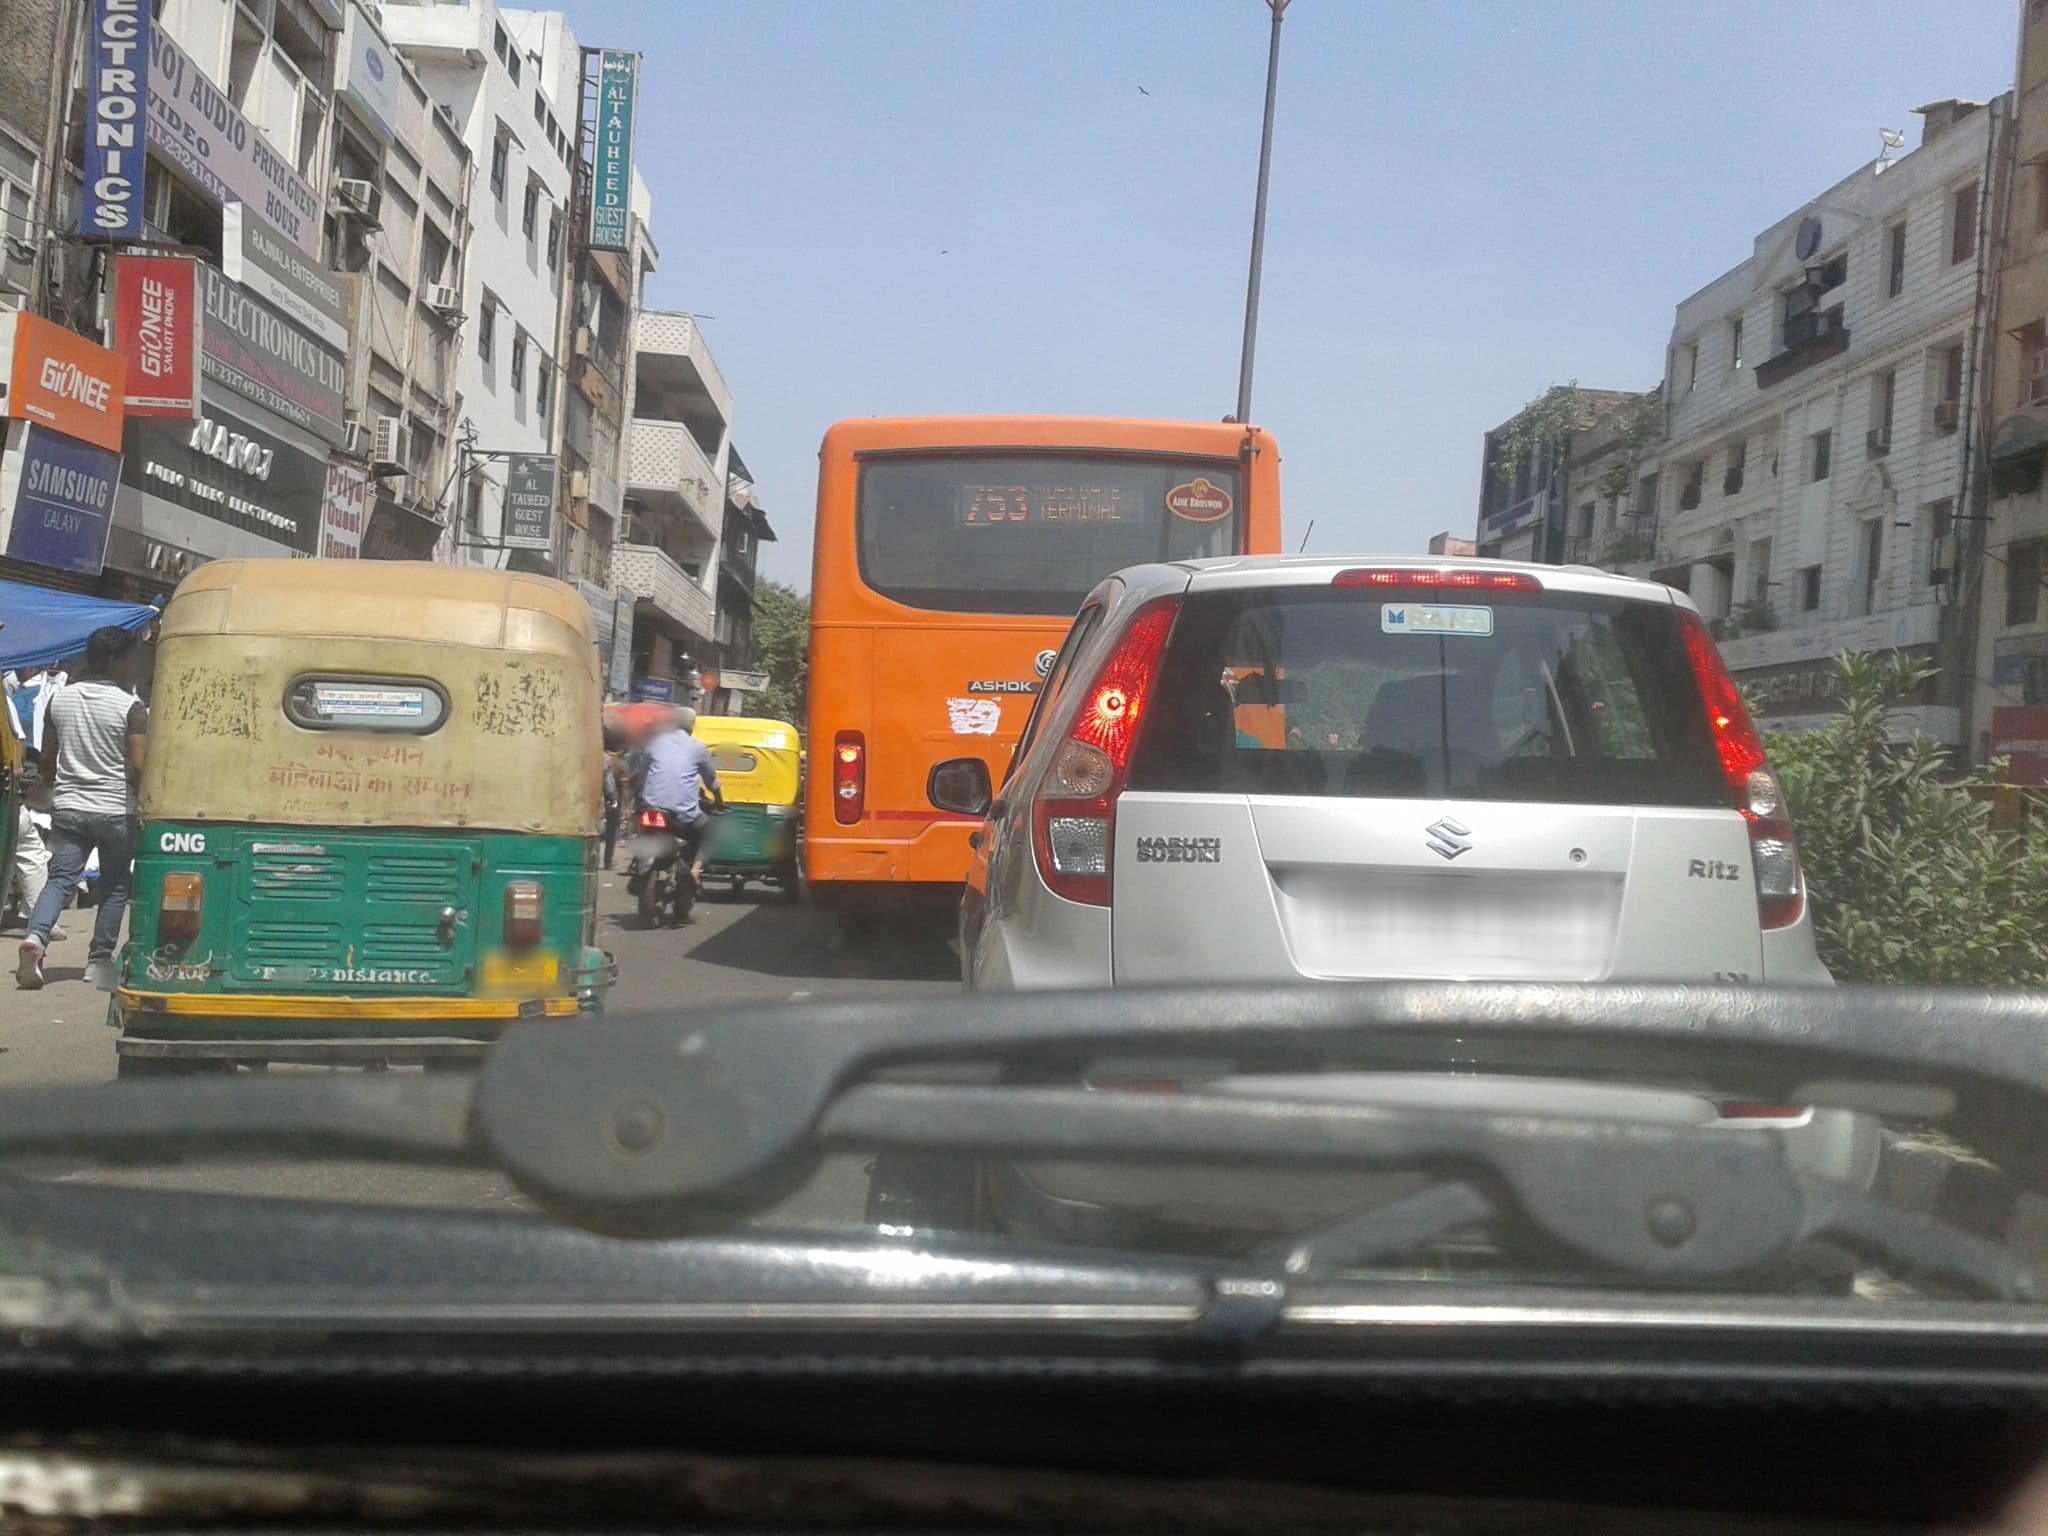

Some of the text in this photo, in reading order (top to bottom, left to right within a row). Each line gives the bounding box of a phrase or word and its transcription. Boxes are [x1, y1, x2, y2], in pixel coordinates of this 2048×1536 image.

[607, 86, 627, 100] AL
[190, 72, 246, 152] AUDIO
[605, 101, 625, 206] TAUHEED
[252, 139, 318, 223] PRIYA GUEST
[266, 189, 300, 242] HOUSE
[595, 205, 626, 226] GUEST
[594, 226, 624, 247] HOUSE
[164, 287, 175, 375] SMART PHONE
[205, 267, 316, 377] ELECTRONICS
[319, 350, 345, 395] LTD
[28, 459, 109, 508] SAMSUNG
[526, 479, 538, 490] AL
[512, 493, 550, 506] TAUHEED
[965, 485, 1027, 521] 753
[44, 508, 82, 534] GALAXY
[229, 495, 298, 534] ELECTRONICS
[515, 509, 544, 521] GUEST
[1040, 501, 1121, 520] TERMINAL
[514, 524, 541, 536] HOUSE
[970, 681, 1033, 692] ASHOK
[160, 832, 206, 853] CNG
[1136, 837, 1221, 849] MARUTI
[1136, 848, 1221, 862] SUZUKI
[1689, 859, 1741, 881] Ritz
